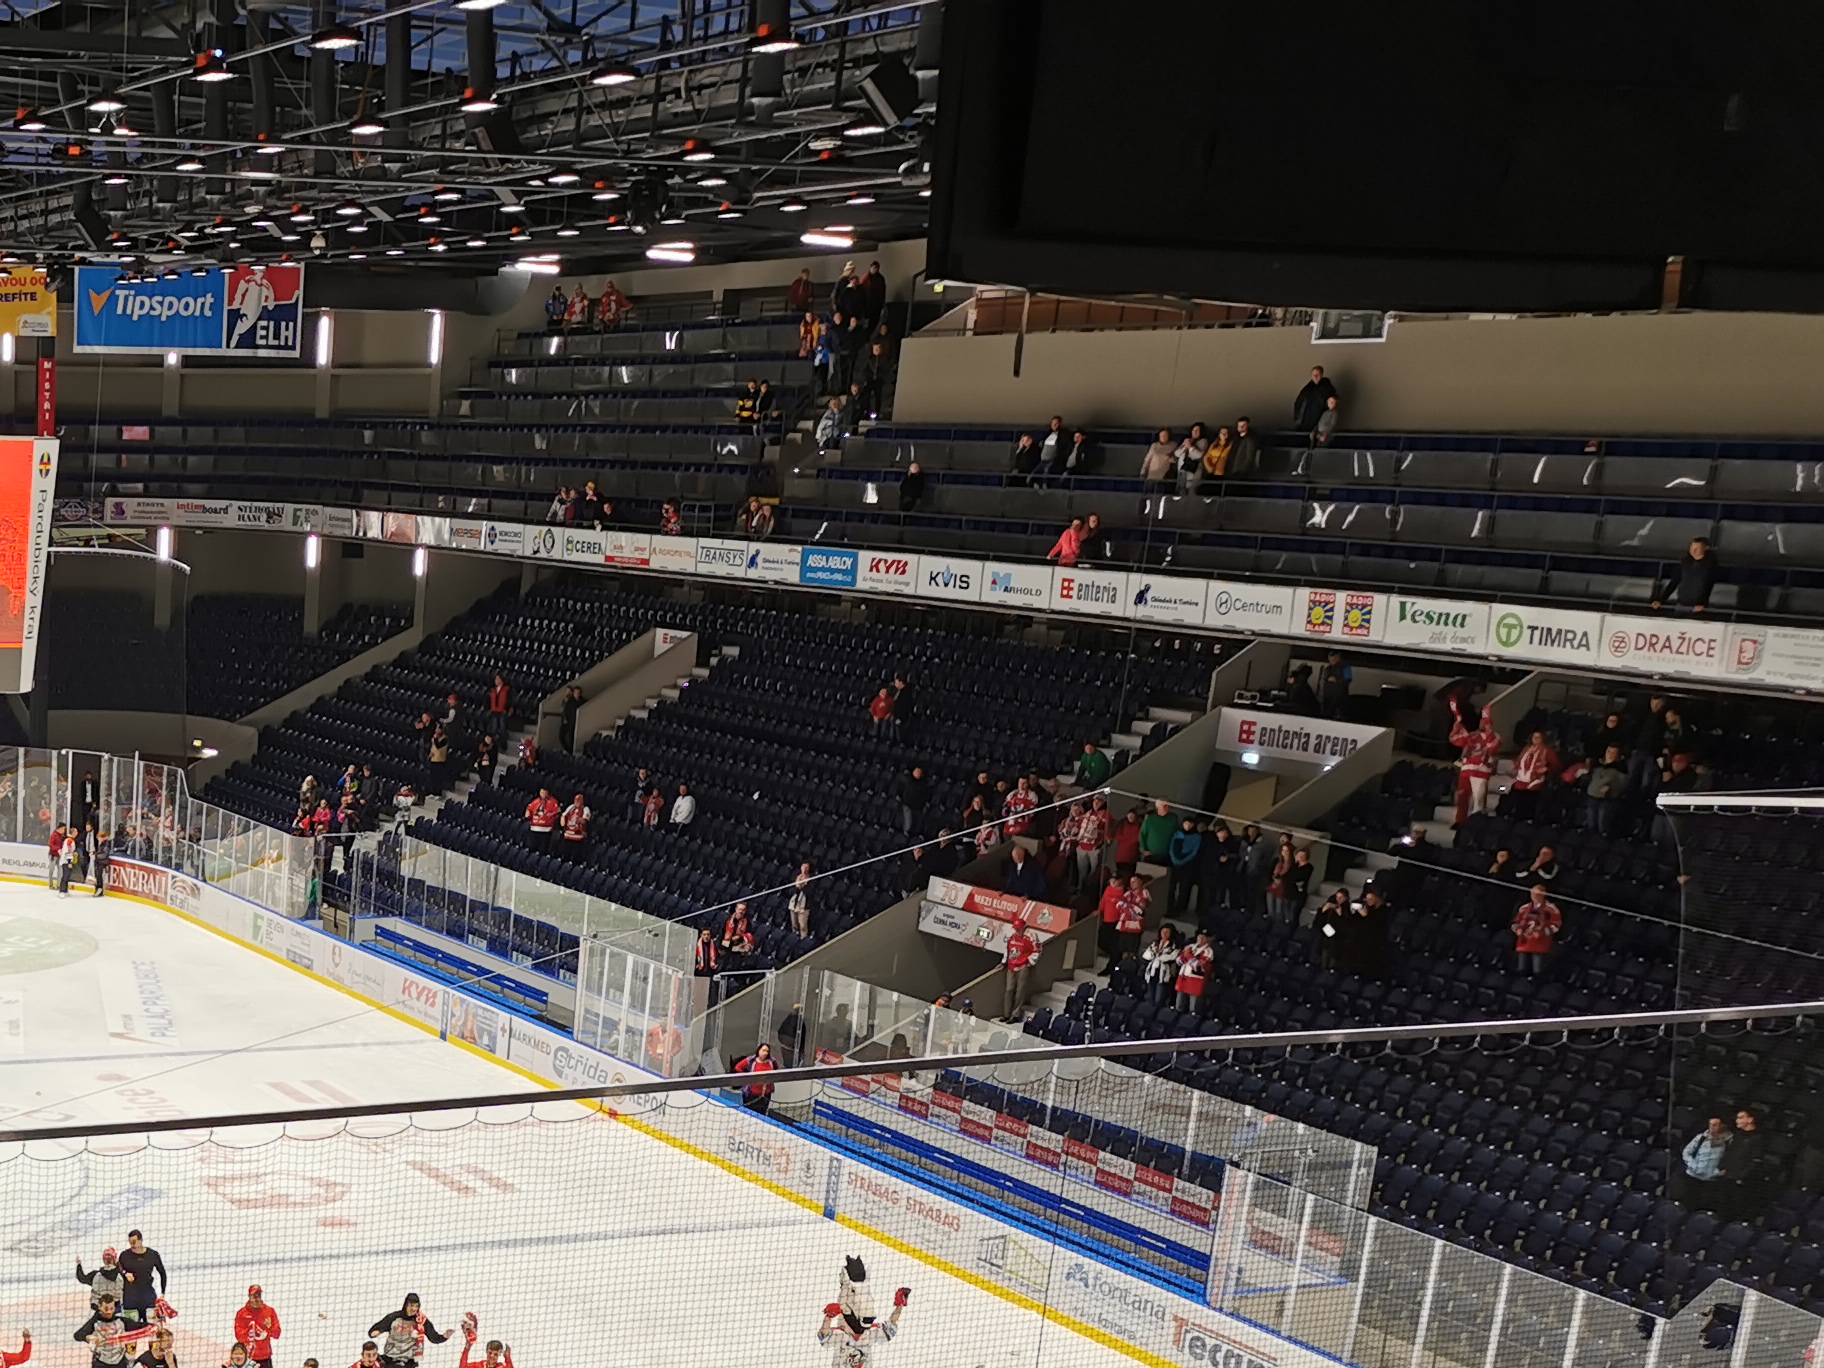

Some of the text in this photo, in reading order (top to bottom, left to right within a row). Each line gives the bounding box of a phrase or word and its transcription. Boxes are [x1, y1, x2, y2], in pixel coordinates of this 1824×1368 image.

[115, 289, 215, 322] Tipsport
[255, 320, 294, 346] ELH
[26, 488, 48, 641] Pardubický kraj
[700, 548, 745, 566] TRANSYS
[869, 557, 909, 576] KYB
[928, 571, 971, 591] KVIS
[1076, 580, 1117, 605] enteria
[1233, 598, 1283, 616] Centrum
[1399, 601, 1469, 629] Vesna
[1526, 625, 1591, 652] TIMRA
[1634, 631, 1718, 659] DRAŽICE
[1258, 724, 1358, 758] enteria arena
[727, 1135, 773, 1168] BARTH
[847, 1171, 961, 1233] STRABAG STRABAG
[1090, 1267, 1169, 1325] fontana
